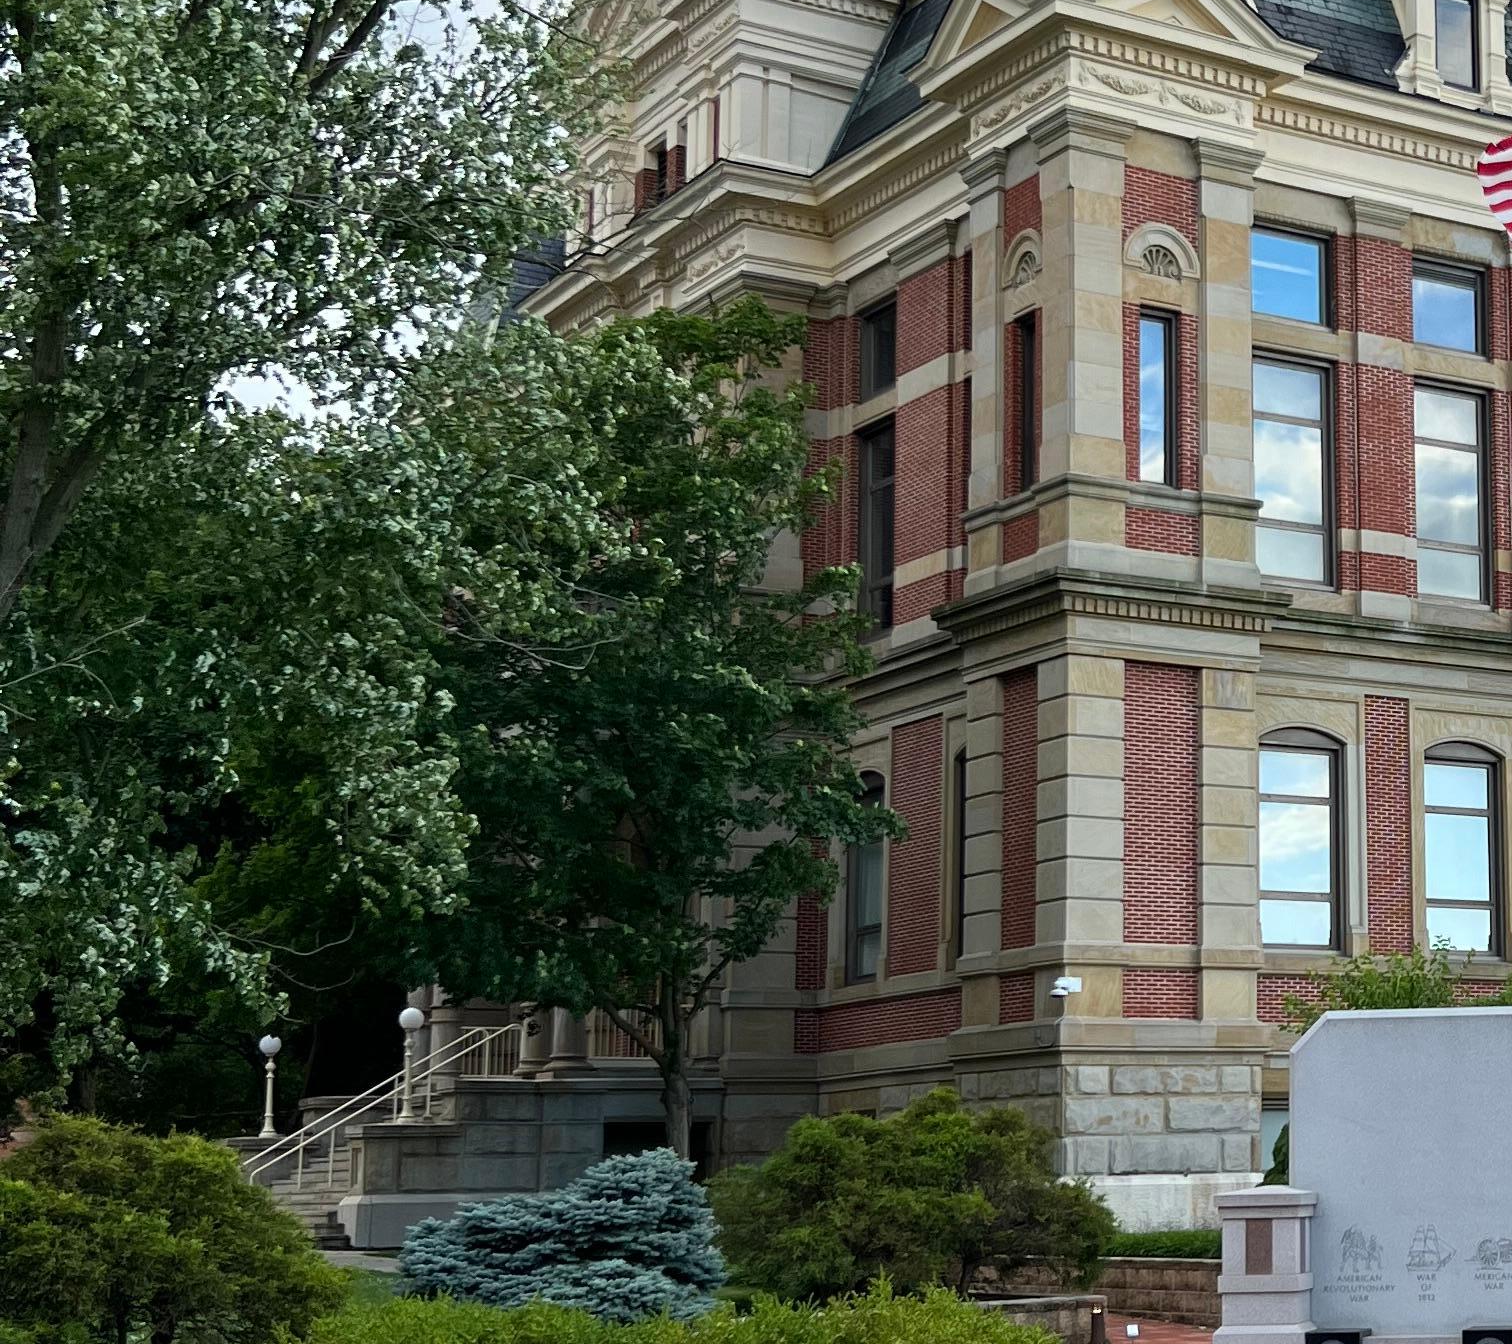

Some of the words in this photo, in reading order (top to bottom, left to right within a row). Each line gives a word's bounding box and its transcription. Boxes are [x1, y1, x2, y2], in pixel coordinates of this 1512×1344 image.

[1336, 1274, 1382, 1282] AMERICAN
[1416, 1273, 1437, 1282] WAR
[1323, 1284, 1396, 1293] REVOLUTIONARY
[1420, 1284, 1433, 1292] OF
[1484, 1282, 1505, 1290] WAR
[1350, 1295, 1369, 1303] WAR
[1418, 1294, 1435, 1302] 1812
